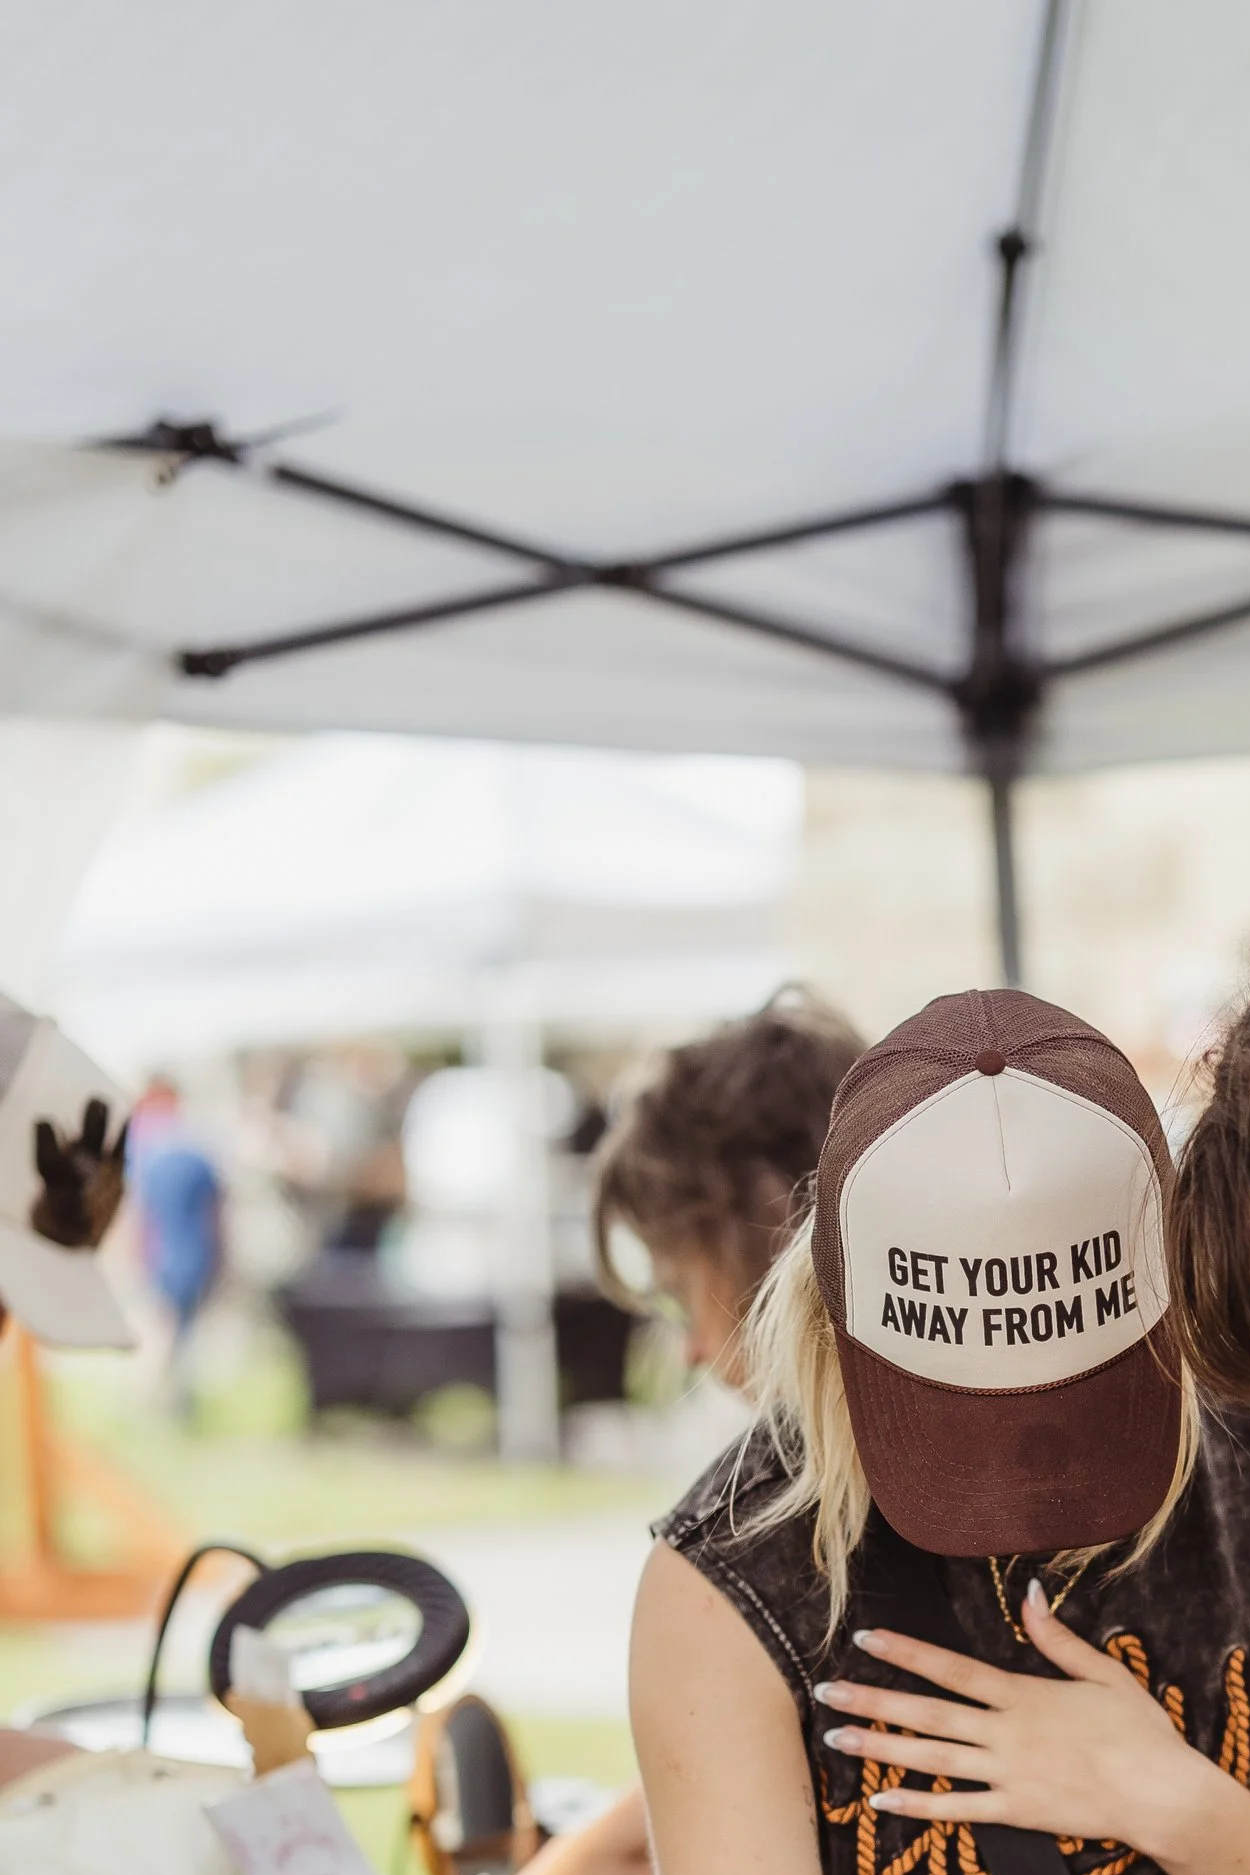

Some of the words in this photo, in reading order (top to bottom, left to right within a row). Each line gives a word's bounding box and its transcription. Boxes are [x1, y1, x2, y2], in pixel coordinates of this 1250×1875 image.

[888, 1247, 948, 1294] GET
[959, 1252, 1060, 1297] YOUR
[1070, 1230, 1122, 1285] KID
[881, 1292, 968, 1345] AWAY
[983, 1295, 1084, 1346] FROM
[1095, 1270, 1138, 1326] ME
